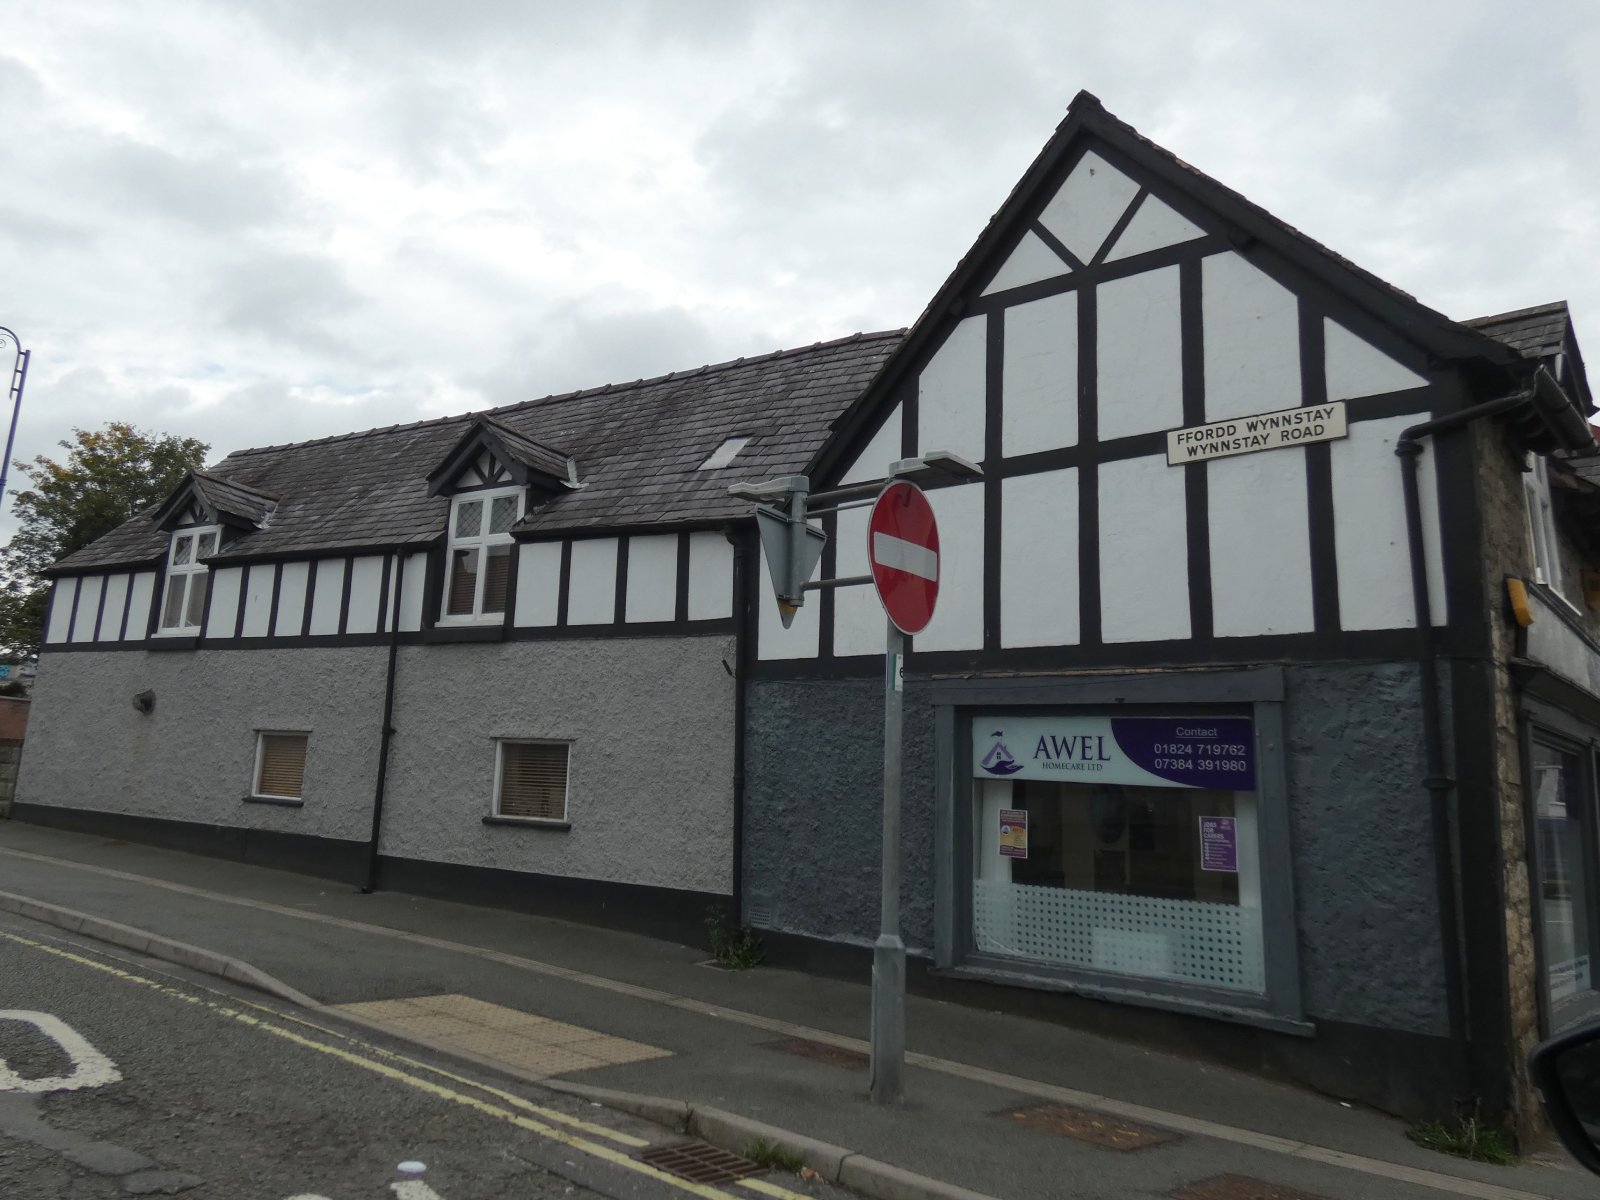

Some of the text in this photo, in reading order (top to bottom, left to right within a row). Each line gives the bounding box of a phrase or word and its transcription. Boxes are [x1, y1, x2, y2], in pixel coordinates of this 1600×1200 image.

[1177, 407, 1335, 445] FFORDD WYNNSTAY
[1187, 424, 1325, 457] WYNNSTAY ROAD
[1175, 726, 1218, 738] Contact
[1032, 735, 1111, 761] AWEL
[1154, 743, 1246, 756] 01824 719762
[1042, 762, 1103, 772] HOMECARE LTD
[1154, 759, 1247, 772] 07384 391980
